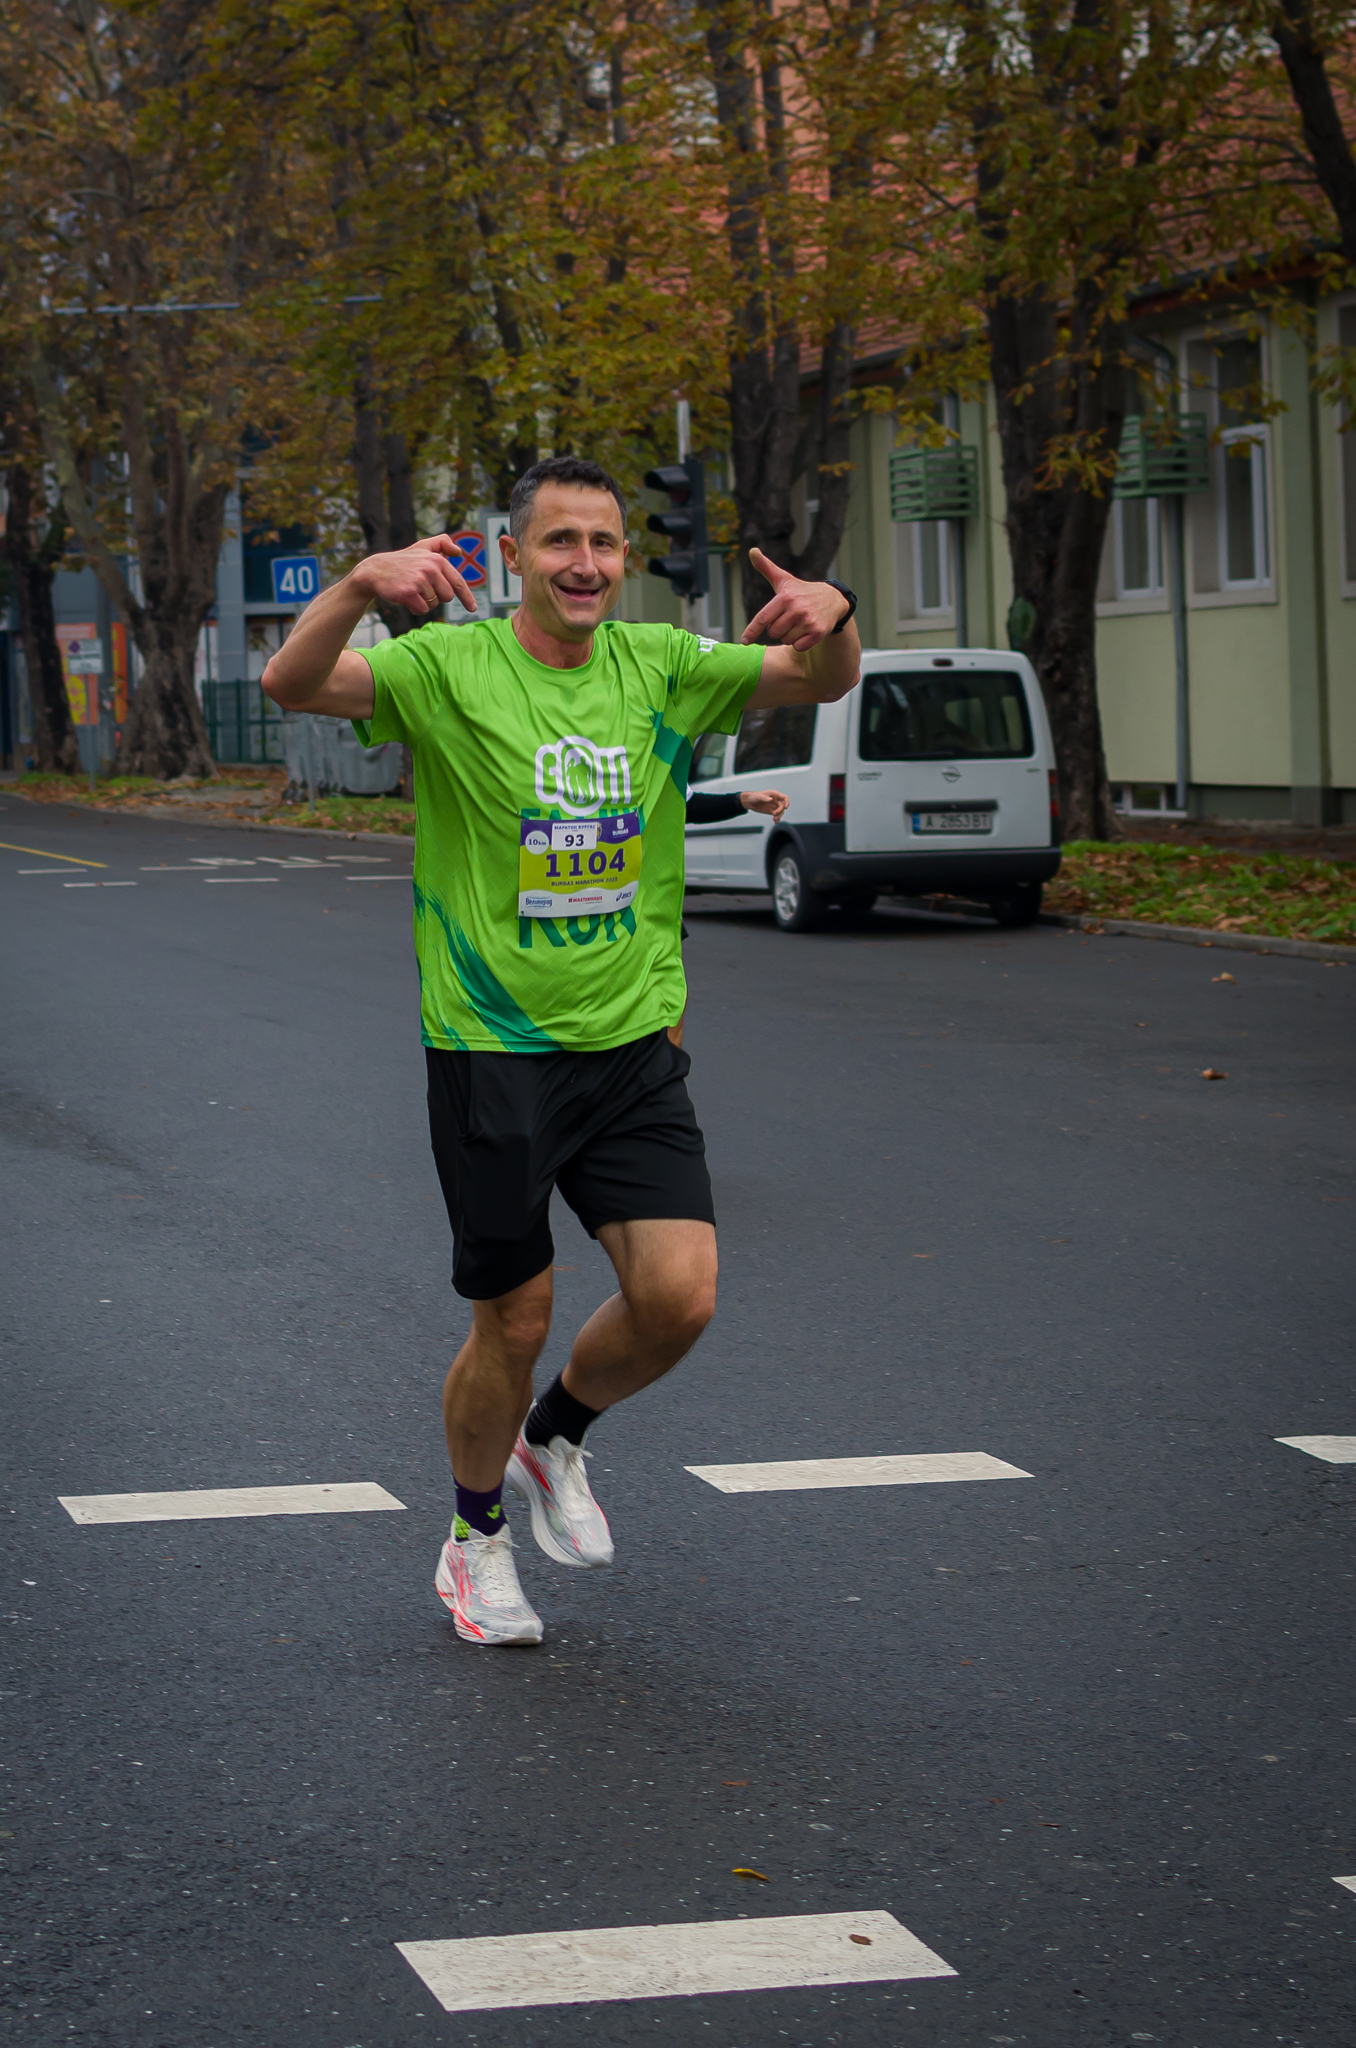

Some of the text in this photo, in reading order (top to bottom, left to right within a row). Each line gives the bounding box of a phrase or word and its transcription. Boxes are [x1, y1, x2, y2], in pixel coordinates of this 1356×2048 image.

[280, 566, 313, 595] 40
[926, 815, 934, 827] A
[564, 834, 584, 847] 93
[546, 848, 625, 877] 1104
[575, 878, 605, 886] MARATHON
